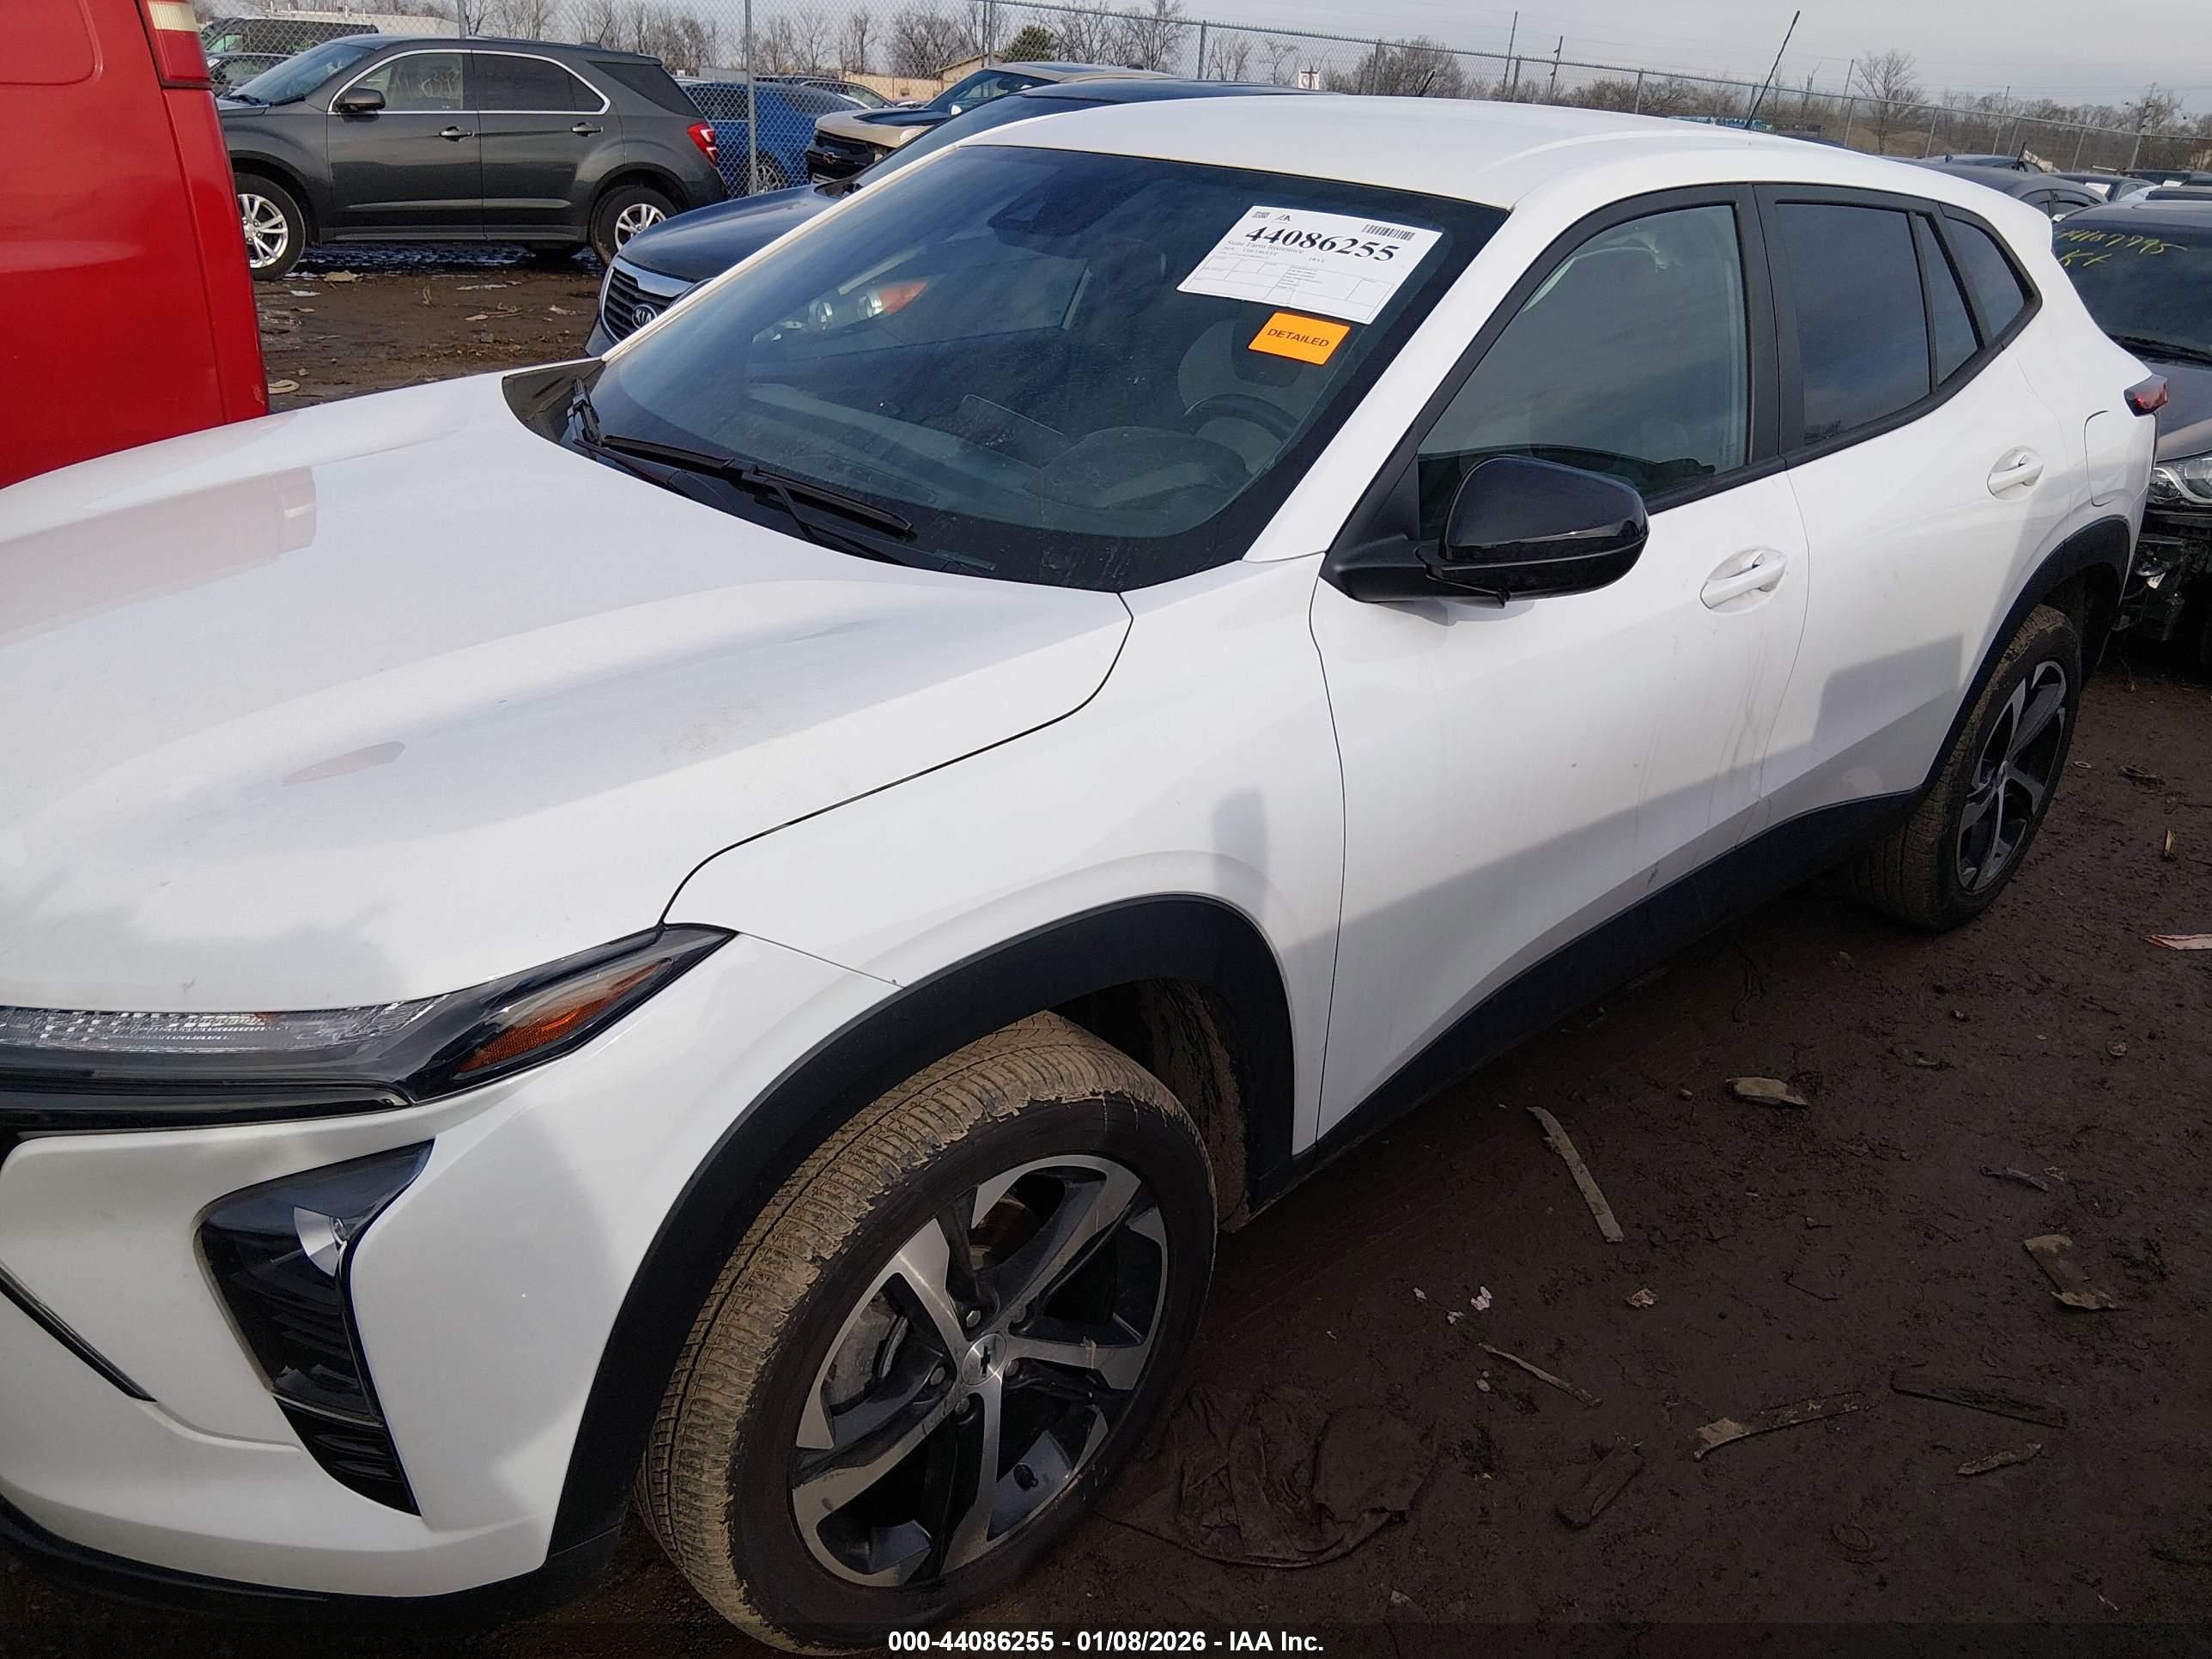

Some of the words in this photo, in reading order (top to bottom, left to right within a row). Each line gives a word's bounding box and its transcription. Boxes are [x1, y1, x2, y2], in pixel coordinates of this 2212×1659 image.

[1245, 226, 1401, 261] 44086255
[635, 309, 652, 325] KIA
[1267, 328, 1329, 348] DETAILED
